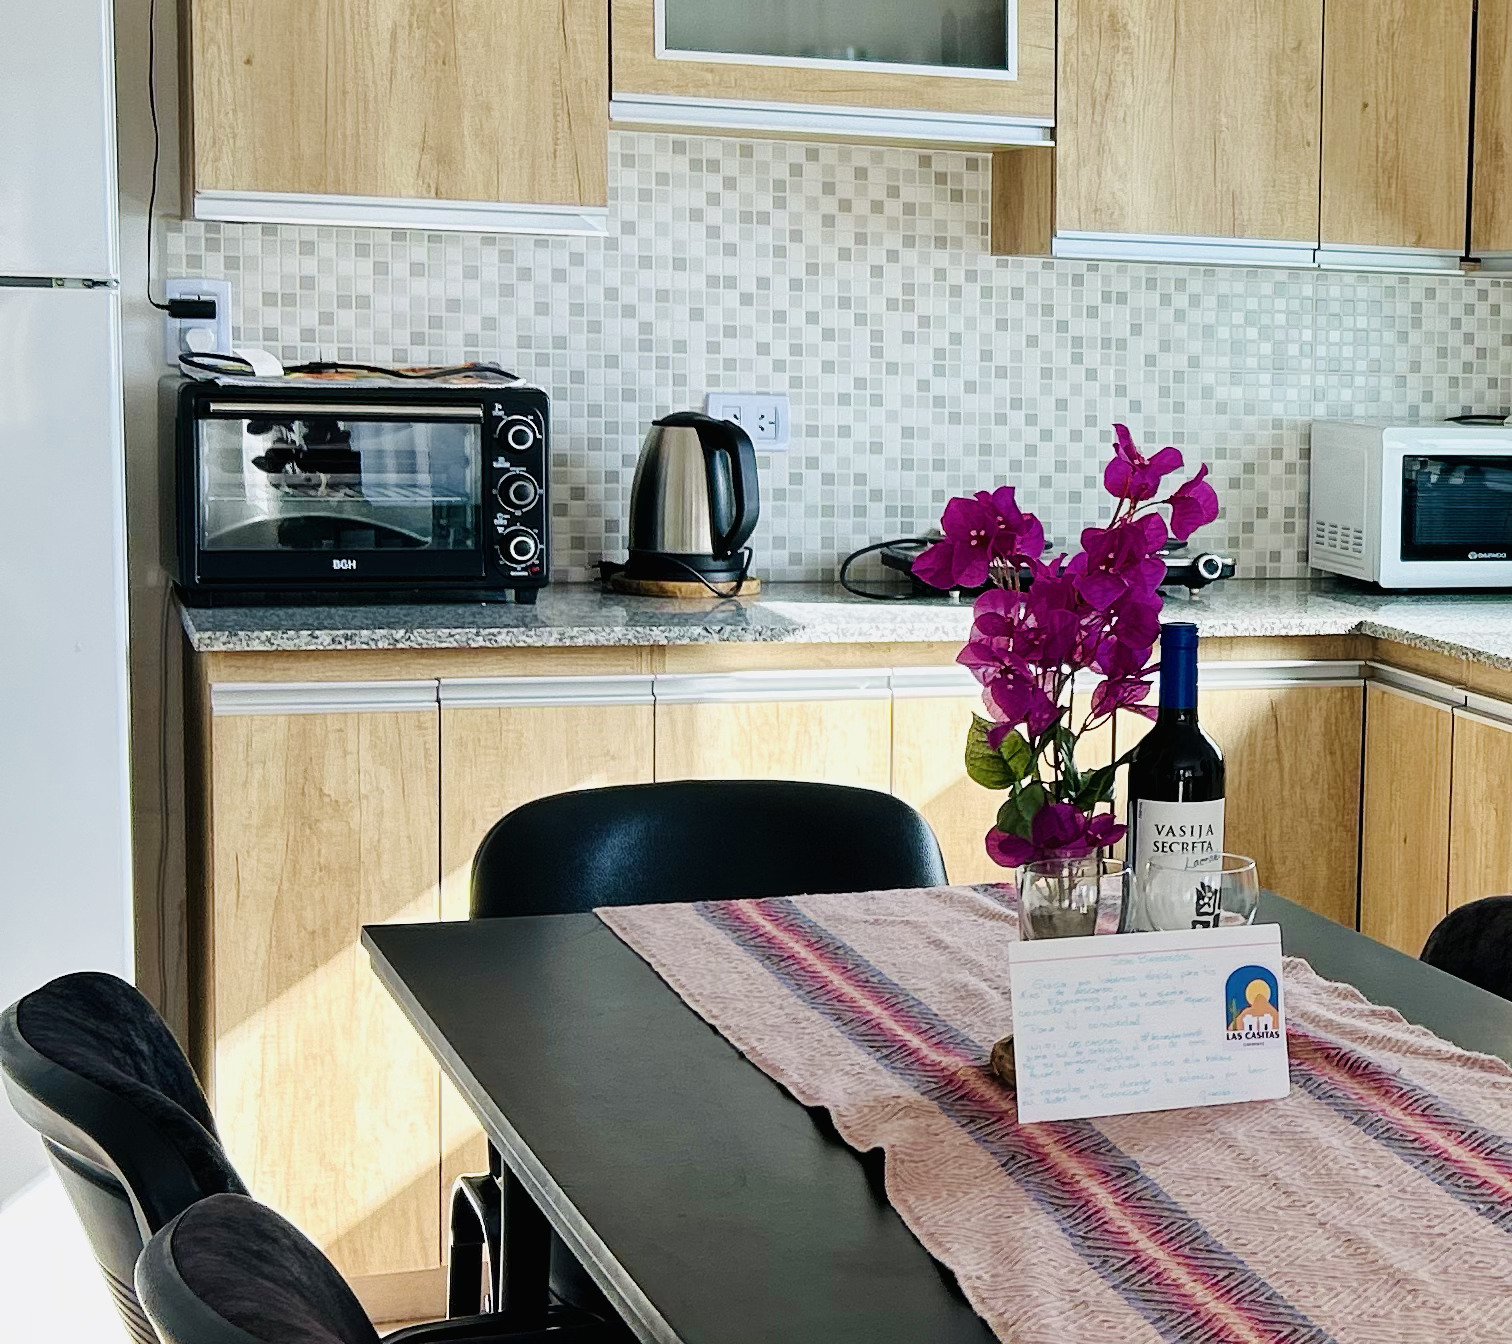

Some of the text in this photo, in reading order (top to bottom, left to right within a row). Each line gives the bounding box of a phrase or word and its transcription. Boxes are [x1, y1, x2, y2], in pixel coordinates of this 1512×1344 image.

[332, 558, 357, 570] BGH
[1154, 823, 1215, 839] VASIJA
[1152, 840, 1215, 855] SECRETA
[1226, 1031, 1280, 1041] LAS CASITAS
